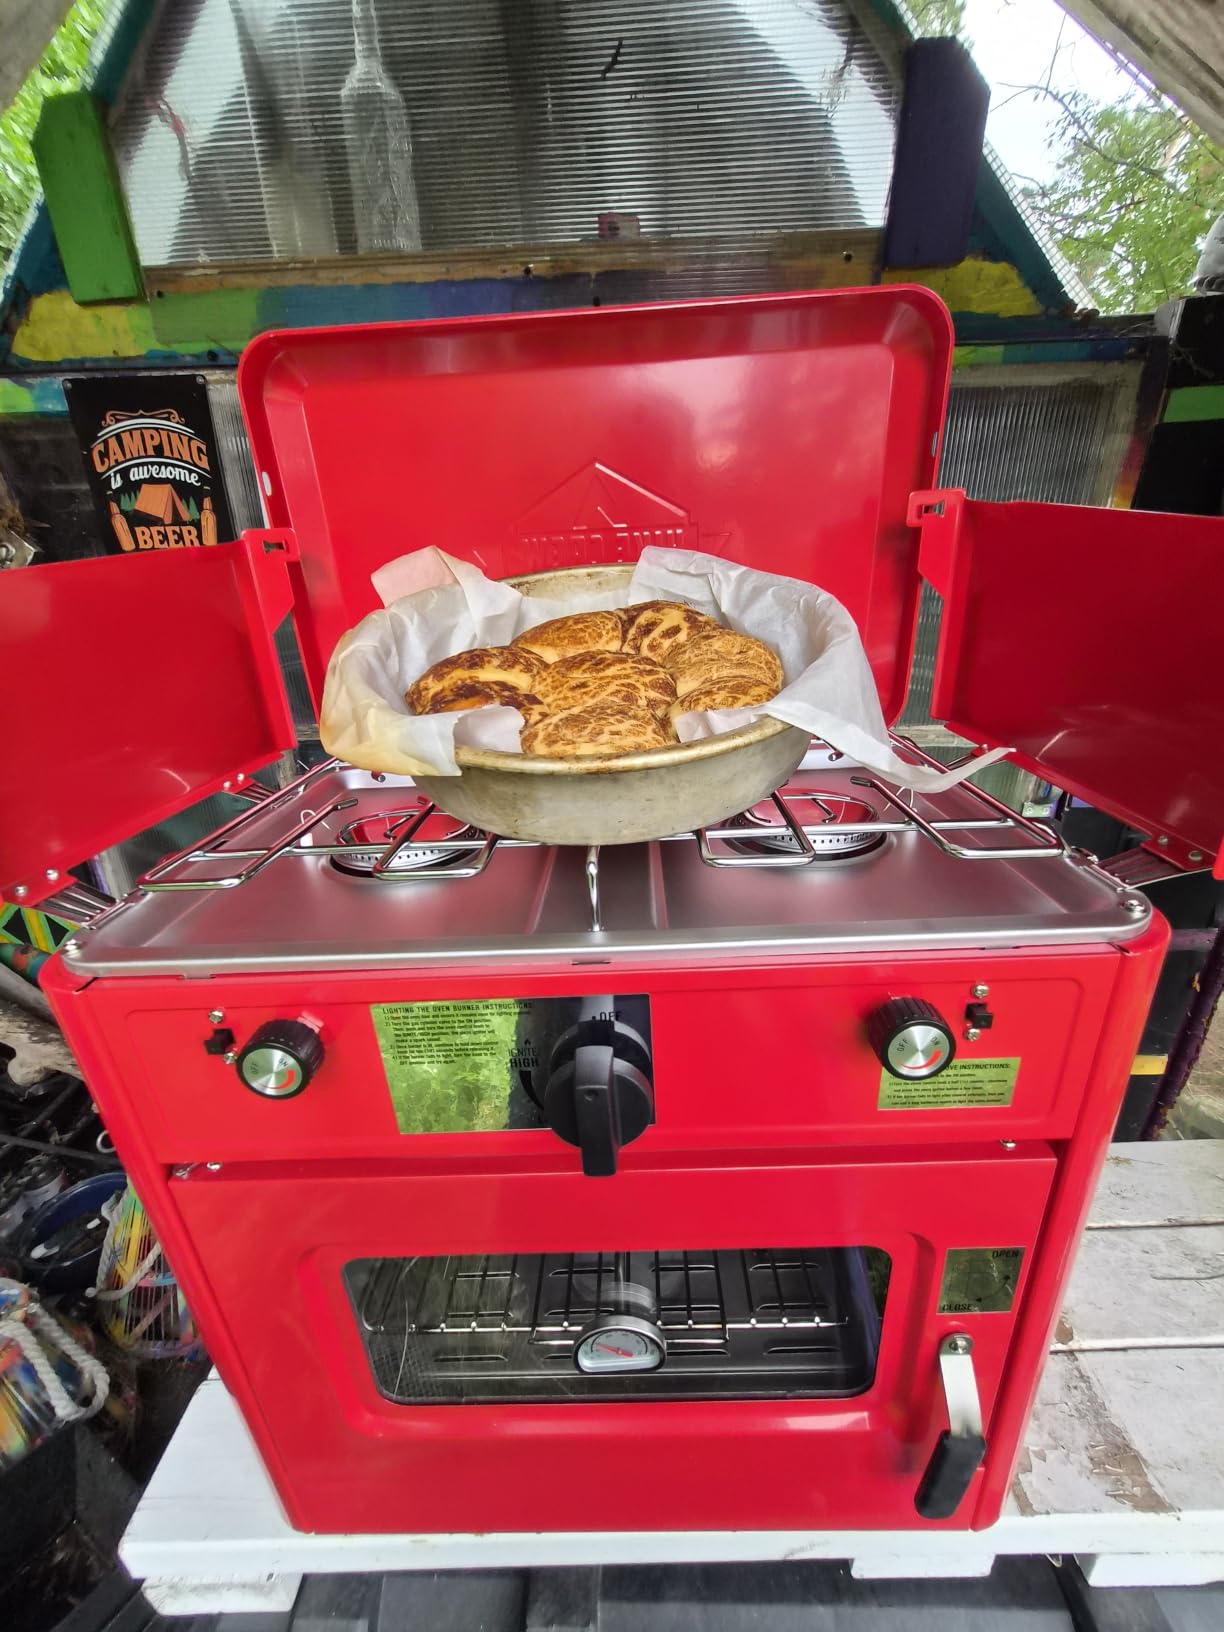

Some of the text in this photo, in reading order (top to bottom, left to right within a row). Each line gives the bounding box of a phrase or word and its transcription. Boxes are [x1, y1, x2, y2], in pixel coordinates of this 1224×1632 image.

[91, 428, 210, 473] CAMPING
[110, 464, 201, 490] is awesome
[134, 525, 200, 549] BEER
[382, 1006, 414, 1015] LIGHTING
[416, 1005, 430, 1013] THE
[599, 1010, 623, 1022] OFF
[896, 1038, 910, 1052] OFF
[507, 1047, 537, 1057] IGNITE
[509, 1057, 539, 1068] HIGH
[991, 1250, 1019, 1259] OPEN
[942, 1303, 971, 1312] CLOSE
